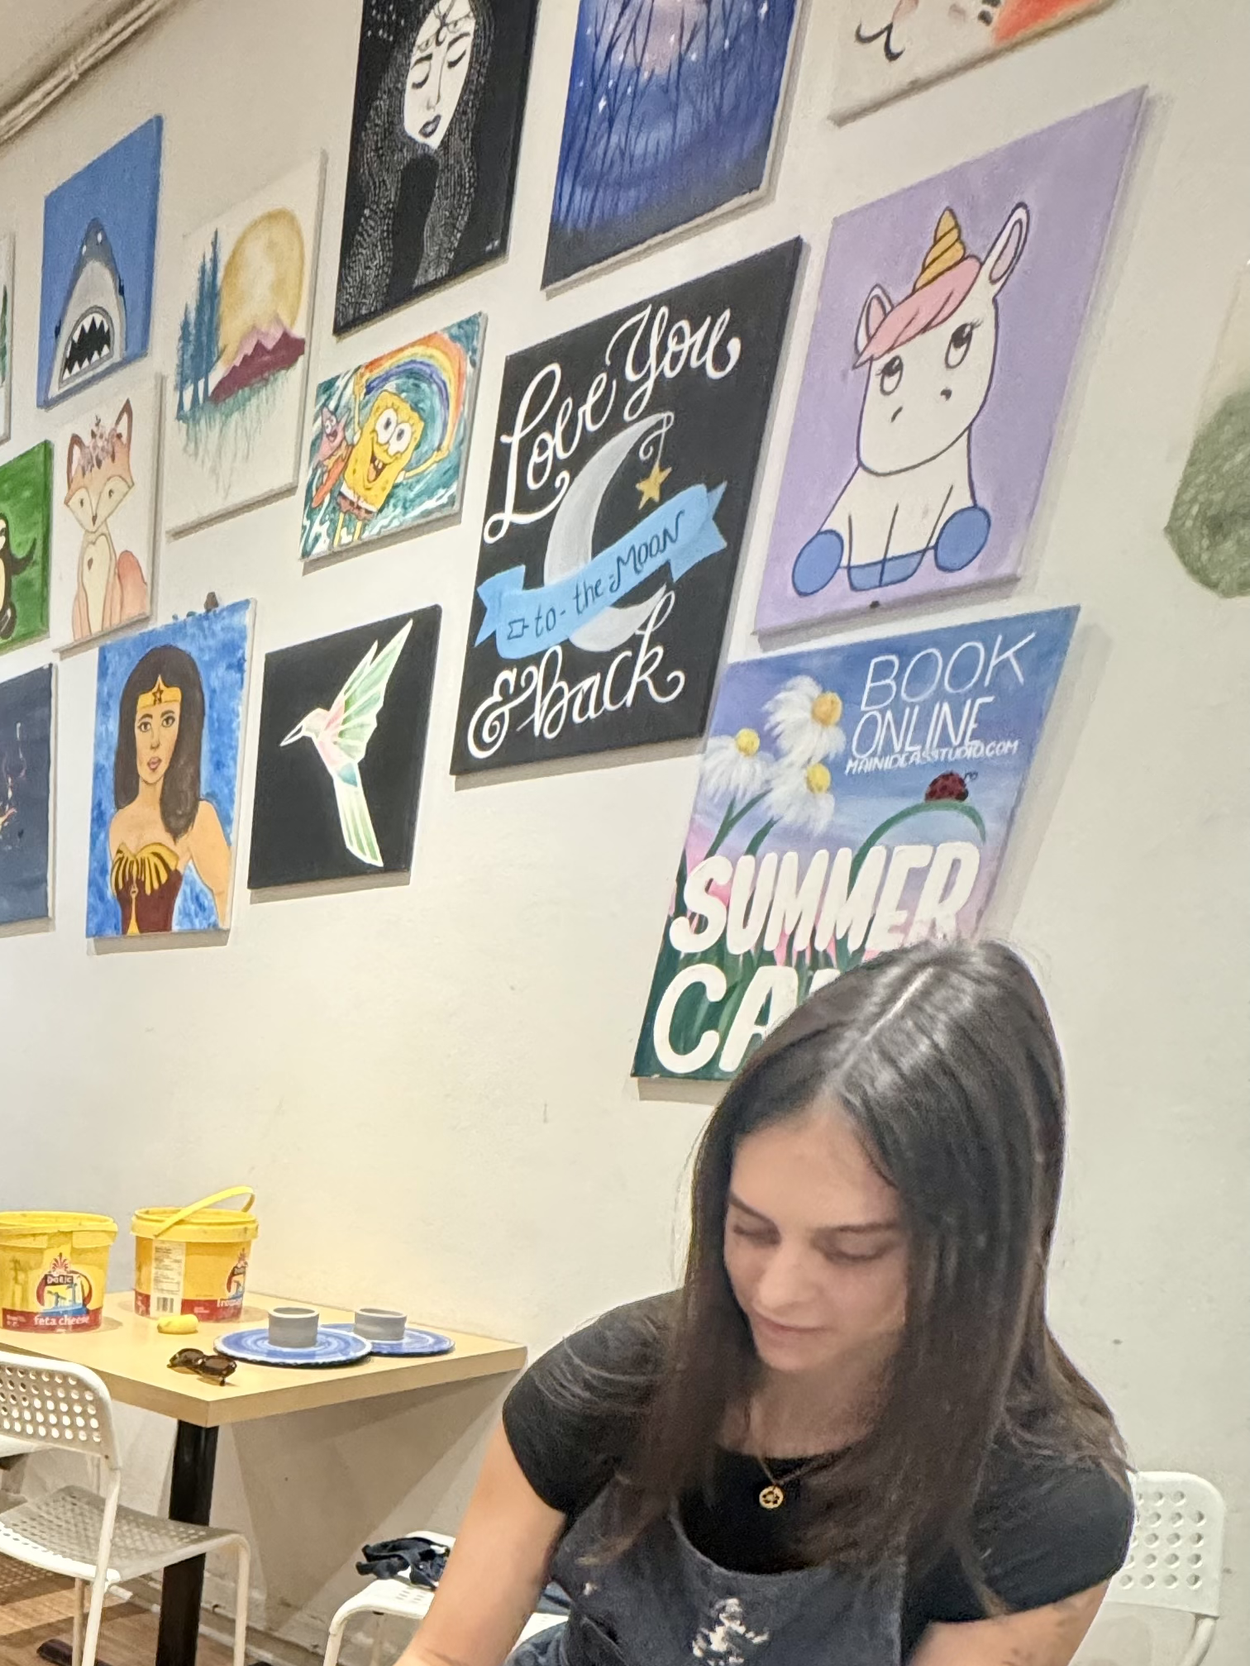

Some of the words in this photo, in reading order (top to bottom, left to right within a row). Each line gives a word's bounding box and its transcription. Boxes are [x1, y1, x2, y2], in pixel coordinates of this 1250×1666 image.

[483, 362, 617, 545] Love
[605, 302, 742, 423] You
[572, 577, 604, 615] the
[860, 630, 1037, 712] BOOK
[851, 695, 995, 760] ONLINE
[669, 840, 981, 955] SUMMER
[652, 963, 842, 1074] CA
